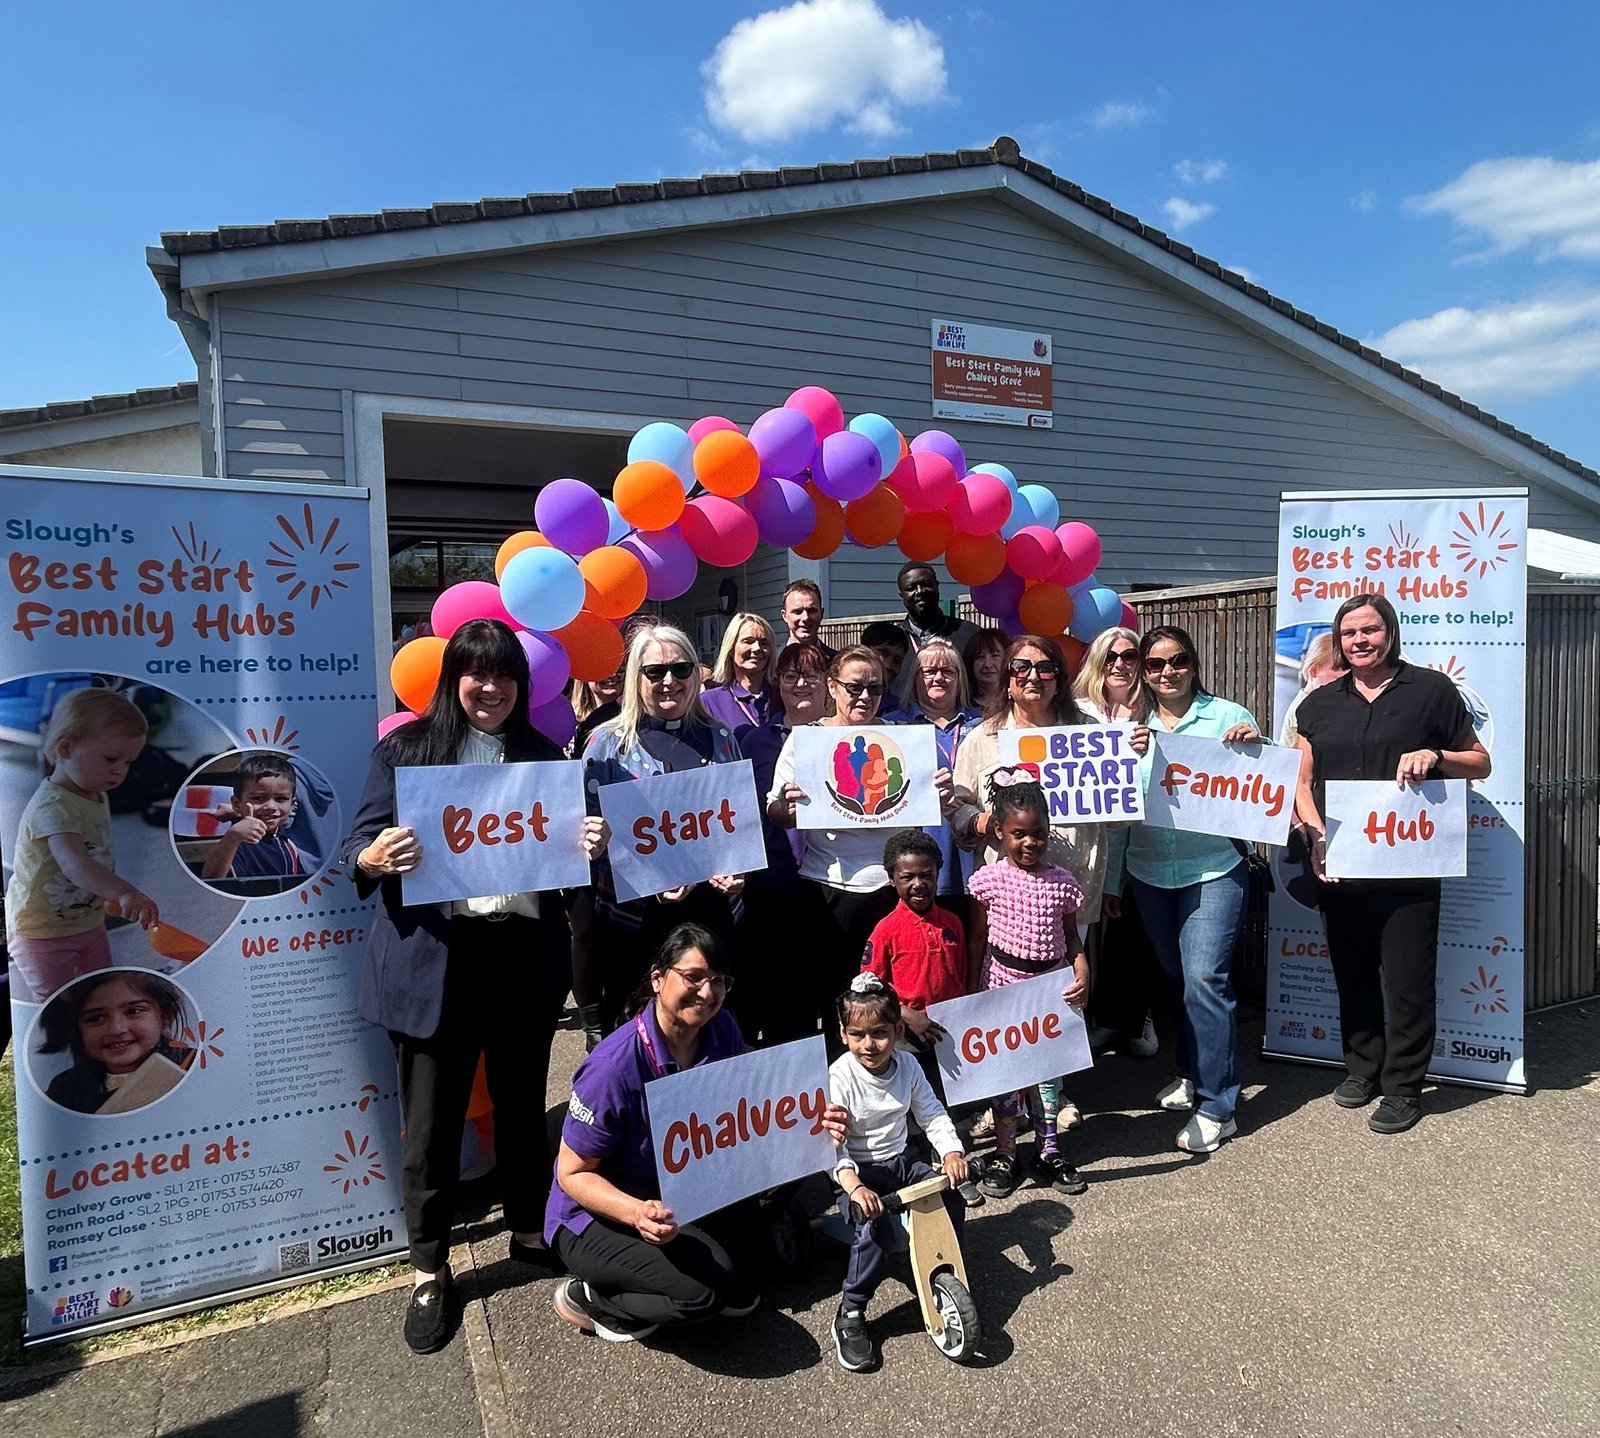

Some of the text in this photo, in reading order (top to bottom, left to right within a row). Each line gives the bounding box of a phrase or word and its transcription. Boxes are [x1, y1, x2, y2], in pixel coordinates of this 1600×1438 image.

[945, 332, 966, 341] START
[947, 325, 963, 334] BEST
[952, 341, 965, 349] LIFE
[945, 356, 1040, 377] Best Start Family Hub
[966, 371, 1022, 386] Chalvey Grove
[1291, 545, 1441, 573] Best Start
[8, 551, 255, 595] Best Start
[1396, 574, 1468, 603] Hubs
[12, 602, 295, 648] Family Hubs
[1400, 611, 1514, 628] here to help!
[146, 653, 359, 676] are here to help!
[1050, 730, 1123, 759] BEST
[1043, 758, 1138, 788] START
[1160, 762, 1285, 817] Family
[830, 801, 842, 814] Best
[1075, 787, 1138, 815] LIFE
[442, 801, 550, 854] Best
[632, 798, 736, 855] Start
[1363, 809, 1435, 847] Hub
[1468, 813, 1504, 829] fer:
[241, 928, 364, 959] We offer:
[1281, 937, 1330, 959] Loca
[250, 963, 267, 972] play
[269, 961, 284, 969] and
[286, 959, 305, 967] learn
[251, 967, 319, 981] parenting support
[1279, 962, 1314, 973] Chalvey
[251, 981, 276, 991] breast
[278, 977, 308, 987] feeding
[309, 975, 325, 983] and
[1279, 972, 1325, 983] Penn Road
[252, 986, 316, 999] weaning support
[252, 992, 338, 1009] oral health information
[253, 1010, 271, 1018] food
[319, 1011, 336, 1019] start
[253, 1029, 284, 1039] support
[285, 1026, 302, 1034] with
[303, 1023, 321, 1031] debt
[323, 1020, 338, 1028] and
[961, 1012, 1062, 1064] Grove
[254, 1041, 268, 1049] pre
[269, 1038, 285, 1046] and
[286, 1035, 304, 1044] post
[305, 1032, 325, 1040] natal
[254, 1051, 268, 1059] pre
[287, 1045, 305, 1054] post
[306, 1041, 326, 1050] natal
[1450, 1040, 1511, 1064] Slough
[255, 1051, 332, 1068] early years provision
[255, 1064, 309, 1077] adult learning
[256, 1076, 294, 1087] parenting
[257, 1087, 287, 1097] support
[301, 1082, 317, 1090] your
[663, 1087, 828, 1174] Chalvey
[45, 1134, 250, 1201] Located at:
[46, 1160, 301, 1220] Chalvey Grove SL1 2TE 01753 574387
[47, 1177, 284, 1236] Penn Road SL2 1PG 01753 574420
[48, 1188, 304, 1251] Romsey Close SL3 8PE 01753 540797
[317, 1225, 393, 1258] Slough
[65, 1298, 100, 1313] START
[68, 1290, 95, 1304] BEST
[64, 1306, 99, 1322] IN LIFE
